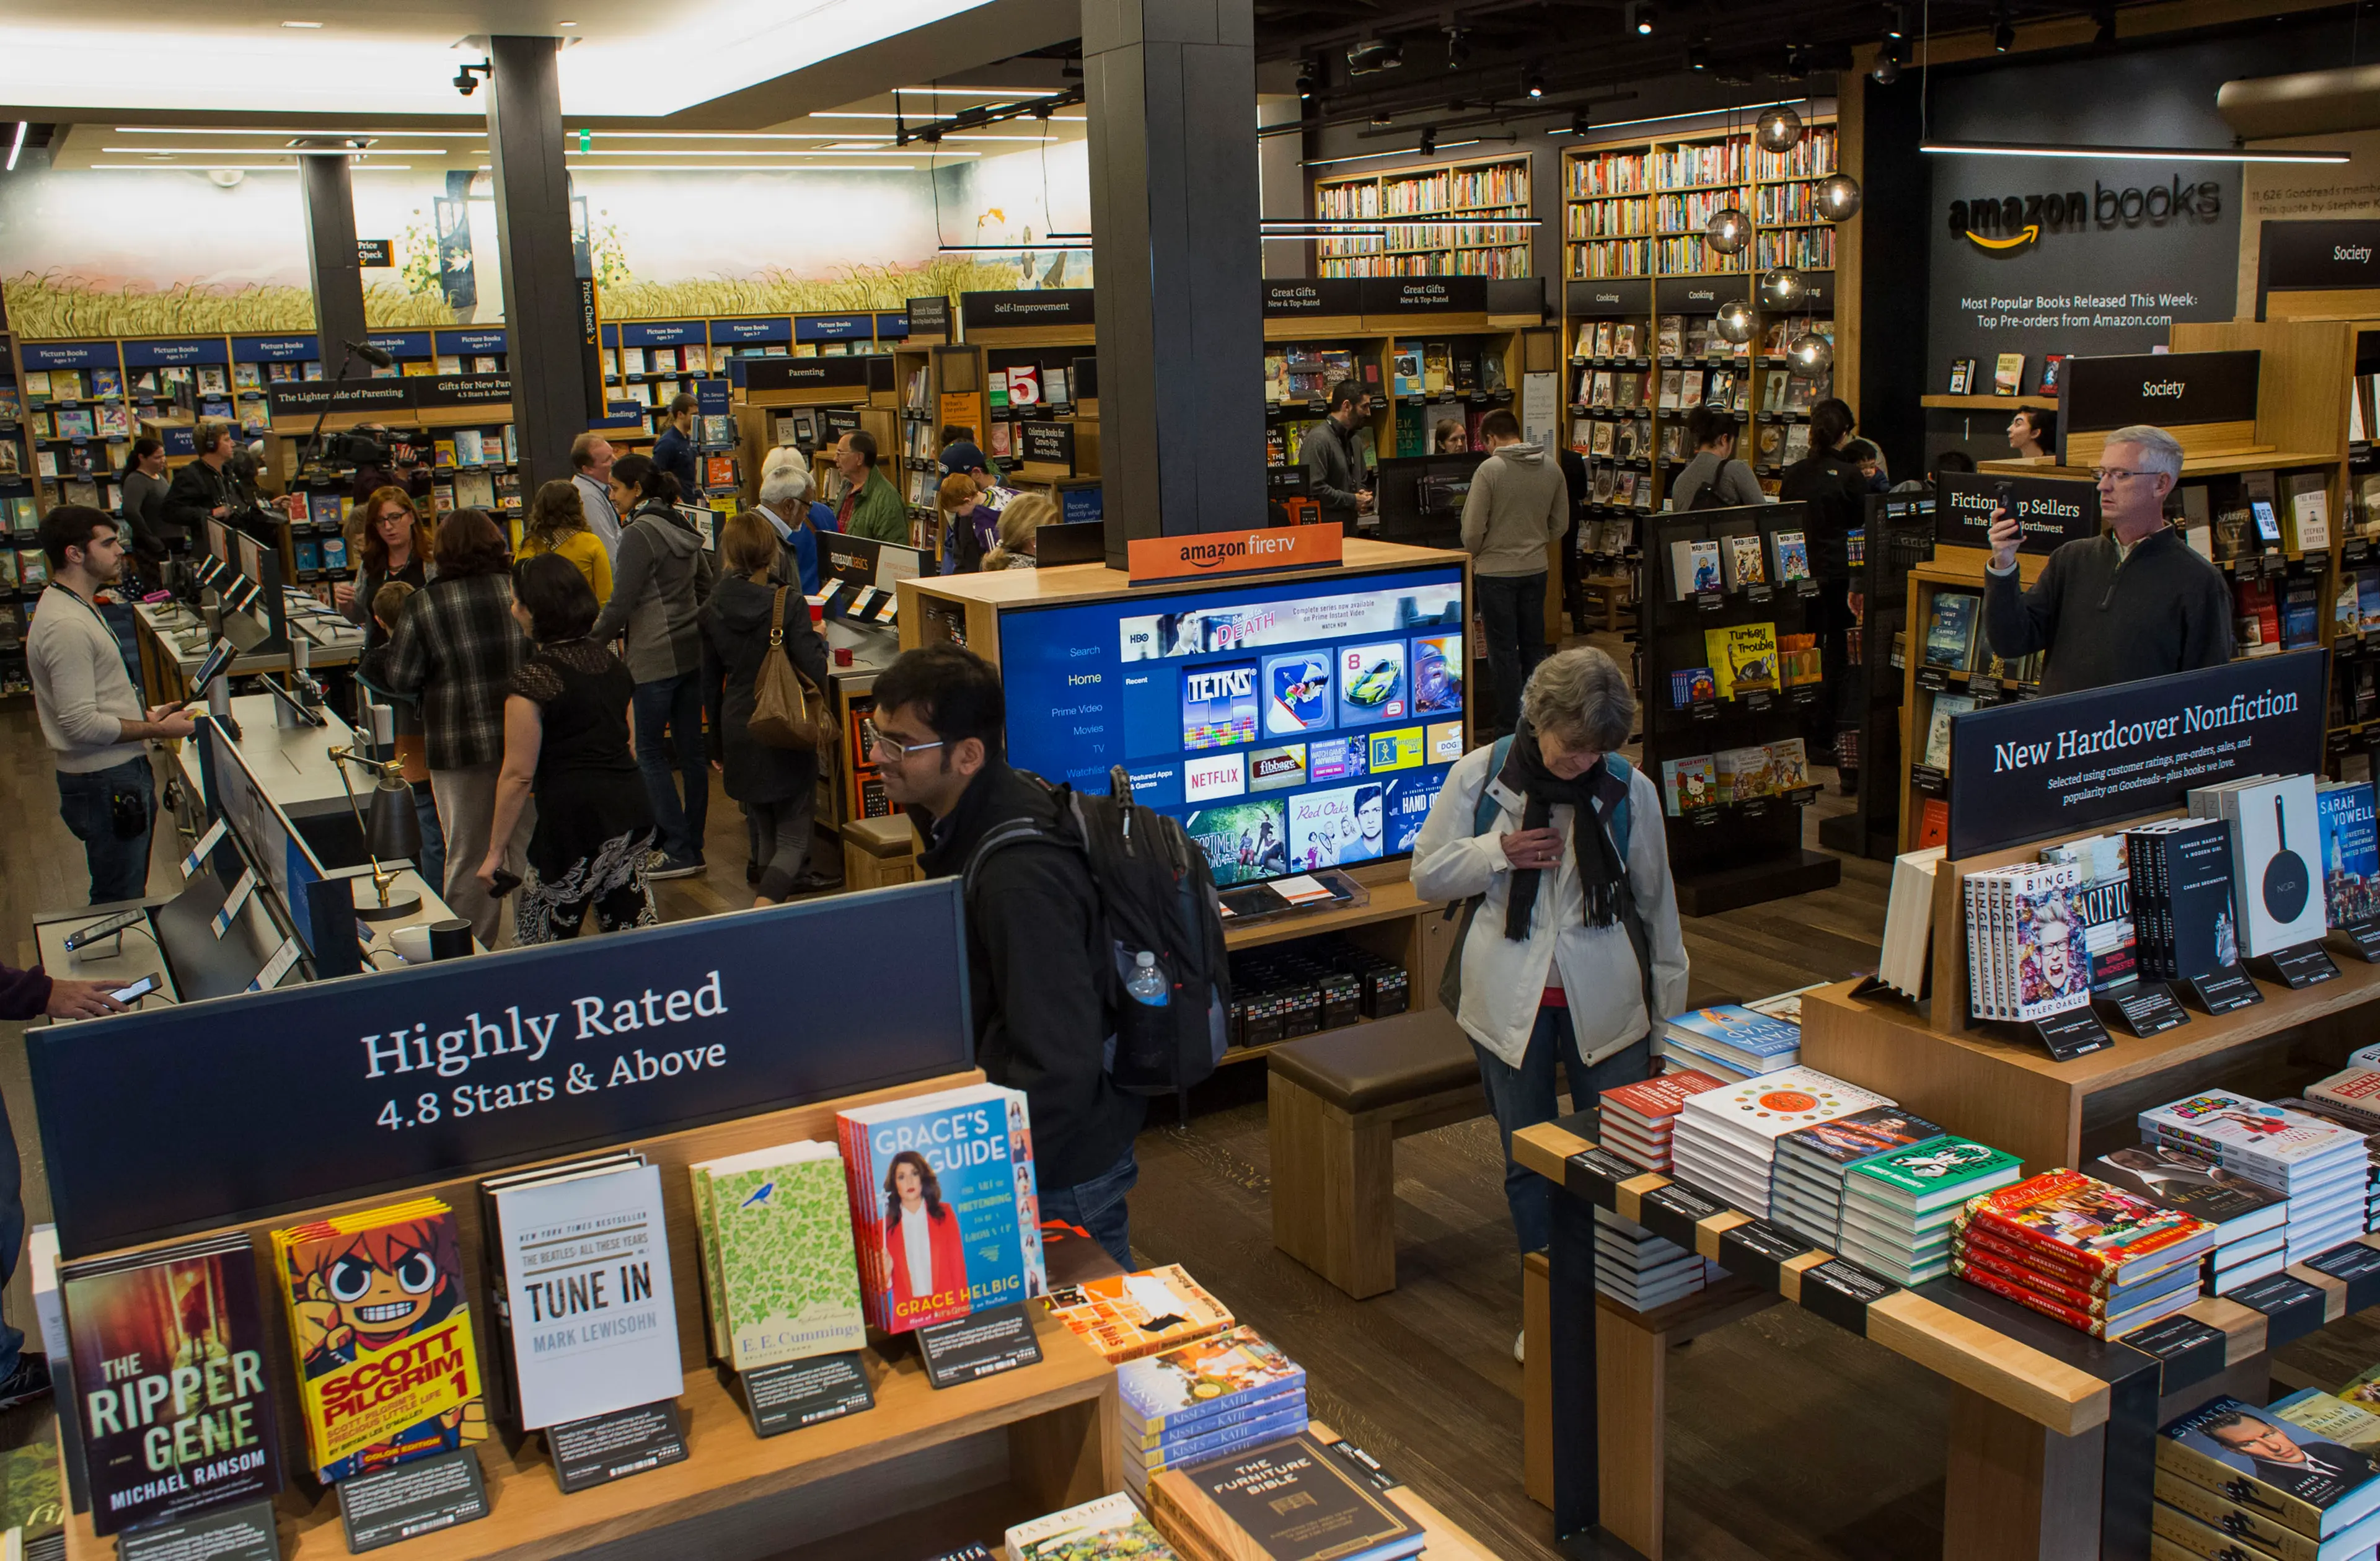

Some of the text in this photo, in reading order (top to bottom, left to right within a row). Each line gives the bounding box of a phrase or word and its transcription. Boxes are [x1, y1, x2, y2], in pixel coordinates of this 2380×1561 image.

[1948, 174, 2222, 231] amazon books
[2259, 205, 2276, 214] this
[2280, 204, 2308, 214] quote
[2311, 203, 2324, 213] by
[2327, 200, 2369, 211] Stephen
[358, 241, 377, 250] Price
[358, 250, 382, 259] Check
[2334, 244, 2371, 263] Society
[1271, 287, 1316, 297] Great Gifts
[1403, 284, 1445, 294] Great Gifts
[1596, 293, 1619, 303] Cooking
[1689, 290, 1714, 300] Cooking
[994, 303, 1070, 313] Self-Improvement
[1289, 299, 1320, 308] Top-Rated
[1421, 296, 1448, 304] Top-Rated
[1962, 293, 2198, 312] Most Popular Books Released This Week:
[585, 305, 594, 334] Check
[1977, 314, 2172, 329] Top Pre-orders from Amazon.com
[789, 368, 824, 377] Parenting
[278, 394, 296, 402] The
[296, 391, 330, 402] Lighter
[351, 390, 360, 399] of
[362, 388, 403, 399] Parenting
[1008, 366, 1039, 404] 5
[2143, 380, 2185, 399] Society
[608, 410, 637, 418] Readings
[1028, 428, 1046, 438] Coloring
[1046, 429, 1057, 437] Books
[1035, 438, 1059, 447] Grown-Ups
[1067, 510, 1086, 518] exactly
[1951, 492, 1998, 510] Fiction
[2032, 499, 2079, 517] Sellers
[1180, 541, 1246, 560] amazon
[1293, 606, 1319, 615] Complete
[1351, 599, 1375, 609] available
[1130, 634, 1149, 643] HBO
[1217, 611, 1276, 648] DEATH
[1729, 627, 1766, 647] Turkey
[1070, 646, 1100, 657] Search
[1737, 639, 1774, 652] Trouble
[1069, 673, 1101, 686] Home
[1126, 676, 1148, 685] Recent
[1189, 668, 1251, 701] TETRIS
[1052, 704, 1103, 717] Prime Video
[1073, 725, 1103, 735] Movies
[1993, 739, 2051, 774] New
[2057, 715, 2179, 761] Hardcover
[2184, 688, 2299, 735] Nonfiction
[1093, 745, 1104, 753] TV
[1393, 736, 1421, 746] Hangman
[1067, 766, 1105, 778] Watchlist
[1260, 757, 1295, 774] fibbage
[2047, 736, 2252, 790] Selected using customer ratings, pre-orders, sales, and
[1191, 767, 1238, 789] NETFLIX
[2063, 783, 2106, 806] popularity
[2107, 782, 2118, 794] on
[2184, 765, 2206, 778] books
[2207, 762, 2218, 772] we
[2219, 758, 2235, 769] love.
[1297, 801, 1349, 821] Red Oaks
[2320, 795, 2355, 815] SARAH
[2332, 806, 2374, 826] VOWELL
[2027, 870, 2073, 891] BINGE
[2201, 875, 2228, 887] BROWNSTEIN
[2025, 995, 2087, 1017] TYLER OAKLEY
[361, 970, 728, 1078] Highly Rated
[1727, 1021, 1784, 1039] NYAD
[1736, 1027, 1801, 1046] DIANA
[376, 1043, 726, 1131] 4.8 Stars & Above
[1636, 1084, 1683, 1107] LITERATURE
[874, 1109, 990, 1156] GRACE'S
[1817, 1127, 1878, 1146] GREATNESS
[1838, 1120, 1899, 1139] THE SCHOOL
[925, 1134, 1007, 1175] GUIDE
[2171, 1177, 2242, 1205] WITCHES
[519, 1211, 647, 1242] NEW YORK TIMES BESTSELLER
[2040, 1239, 2078, 1259] DINNERTIME
[2124, 1224, 2193, 1254] REE DRUMMOND
[525, 1260, 653, 1323] TUNE IN
[896, 1274, 1020, 1317] GRACE HELBIG
[533, 1311, 657, 1353] MARK LEWISOHN
[742, 1322, 860, 1354] E. E. Cummings
[100, 1352, 143, 1382] THE
[320, 1325, 459, 1406] SCOTT
[87, 1349, 265, 1439] RIPPER
[324, 1346, 464, 1428] PILGRIM
[451, 1369, 469, 1399] 1
[327, 1392, 416, 1439] SCOTT PILGRIM'S
[328, 1389, 442, 1447] PRECIOUS LITTLE LIFE
[2172, 1399, 2242, 1438] SINATRA
[143, 1401, 259, 1473] GENE
[1214, 1457, 1311, 1494] FURNITURE
[1235, 1458, 1271, 1475] THE
[111, 1472, 190, 1511] MICHAEL
[193, 1449, 265, 1487] RANSOM
[1246, 1472, 1298, 1495] BIBLE
[2295, 1475, 2319, 1492] JAMES
[2302, 1479, 2332, 1497] KAPLAN
[1016, 1497, 1128, 1538] JAN KARON
